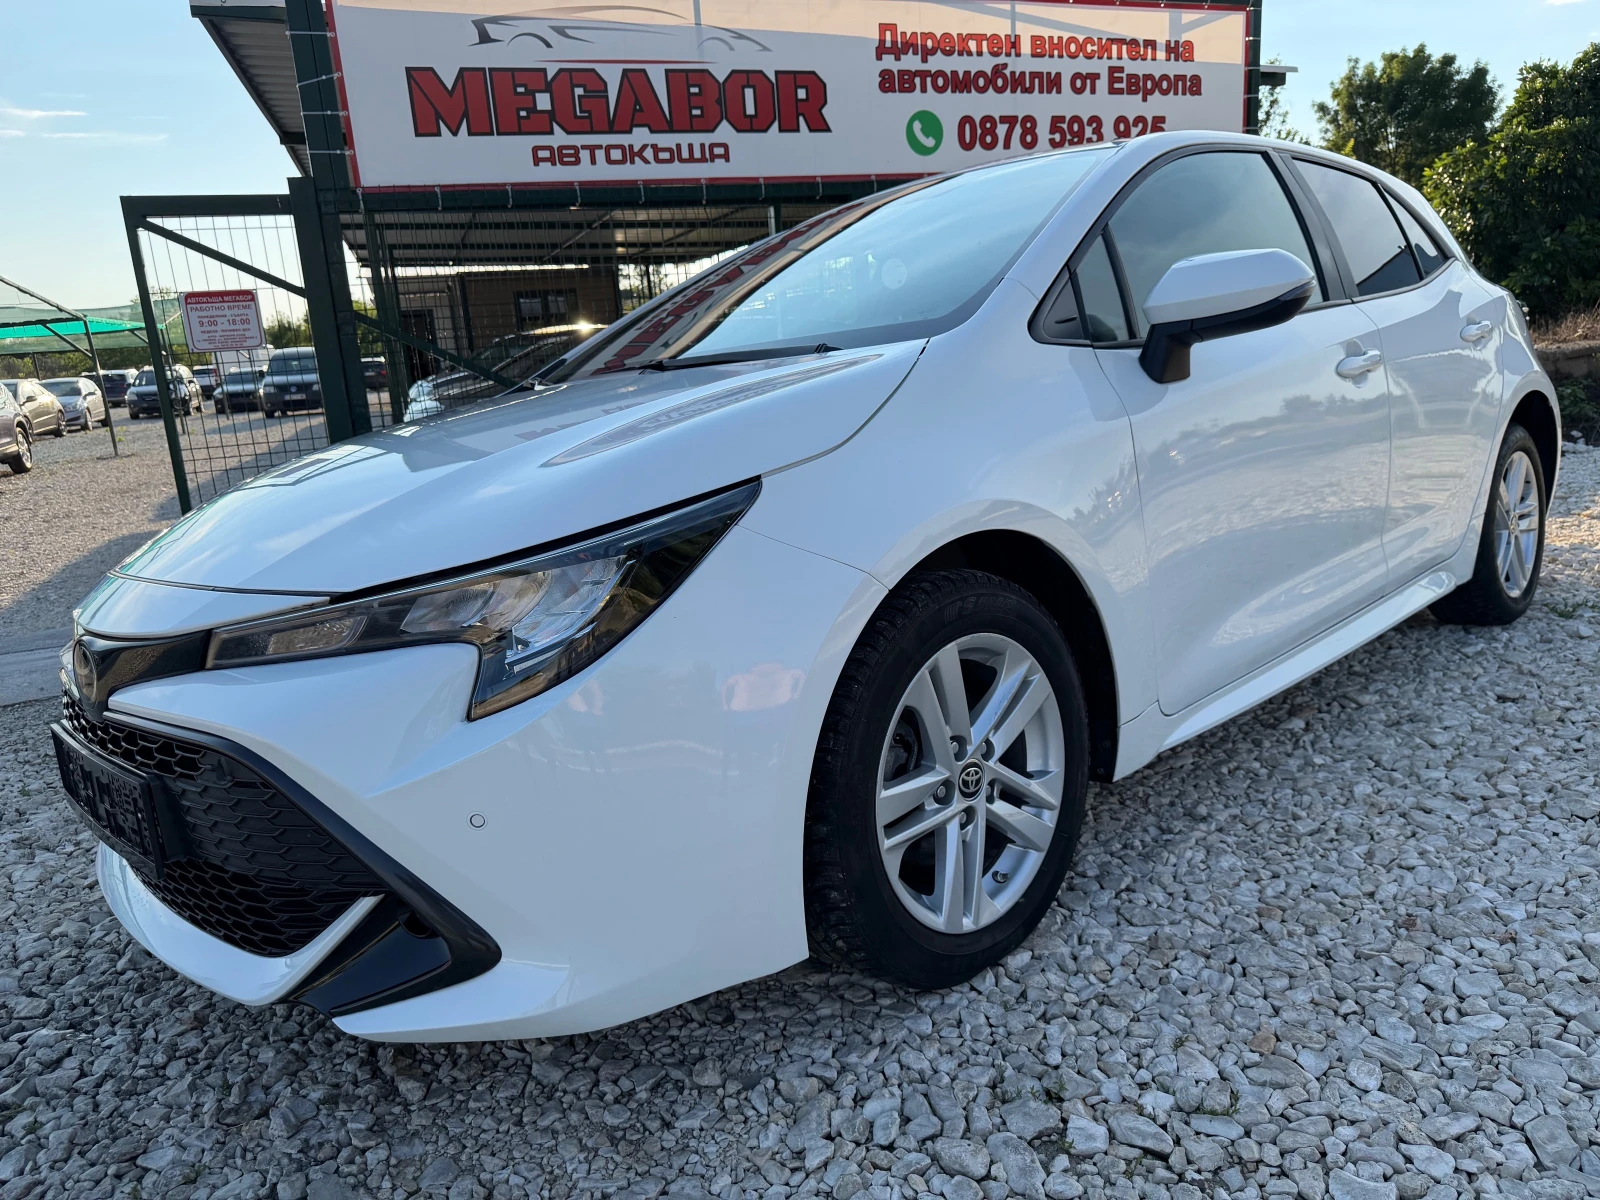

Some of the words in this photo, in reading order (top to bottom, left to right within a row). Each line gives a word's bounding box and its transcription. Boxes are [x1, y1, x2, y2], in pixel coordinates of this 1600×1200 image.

[876, 23, 1020, 62] Директен
[1031, 35, 1157, 61] вносител
[1165, 39, 1195, 62] на
[878, 64, 1061, 94] автомобили
[1070, 71, 1100, 94] от
[1107, 66, 1202, 101] Европа
[405, 66, 832, 137] MEGABOR
[958, 115, 1038, 150] 0878
[1048, 115, 1104, 149] 593
[531, 142, 731, 167] АВТОКЪЩА
[198, 319, 218, 328] 9:00
[227, 318, 251, 326] 18:00
[227, 303, 253, 311] ВРЕМЕ
